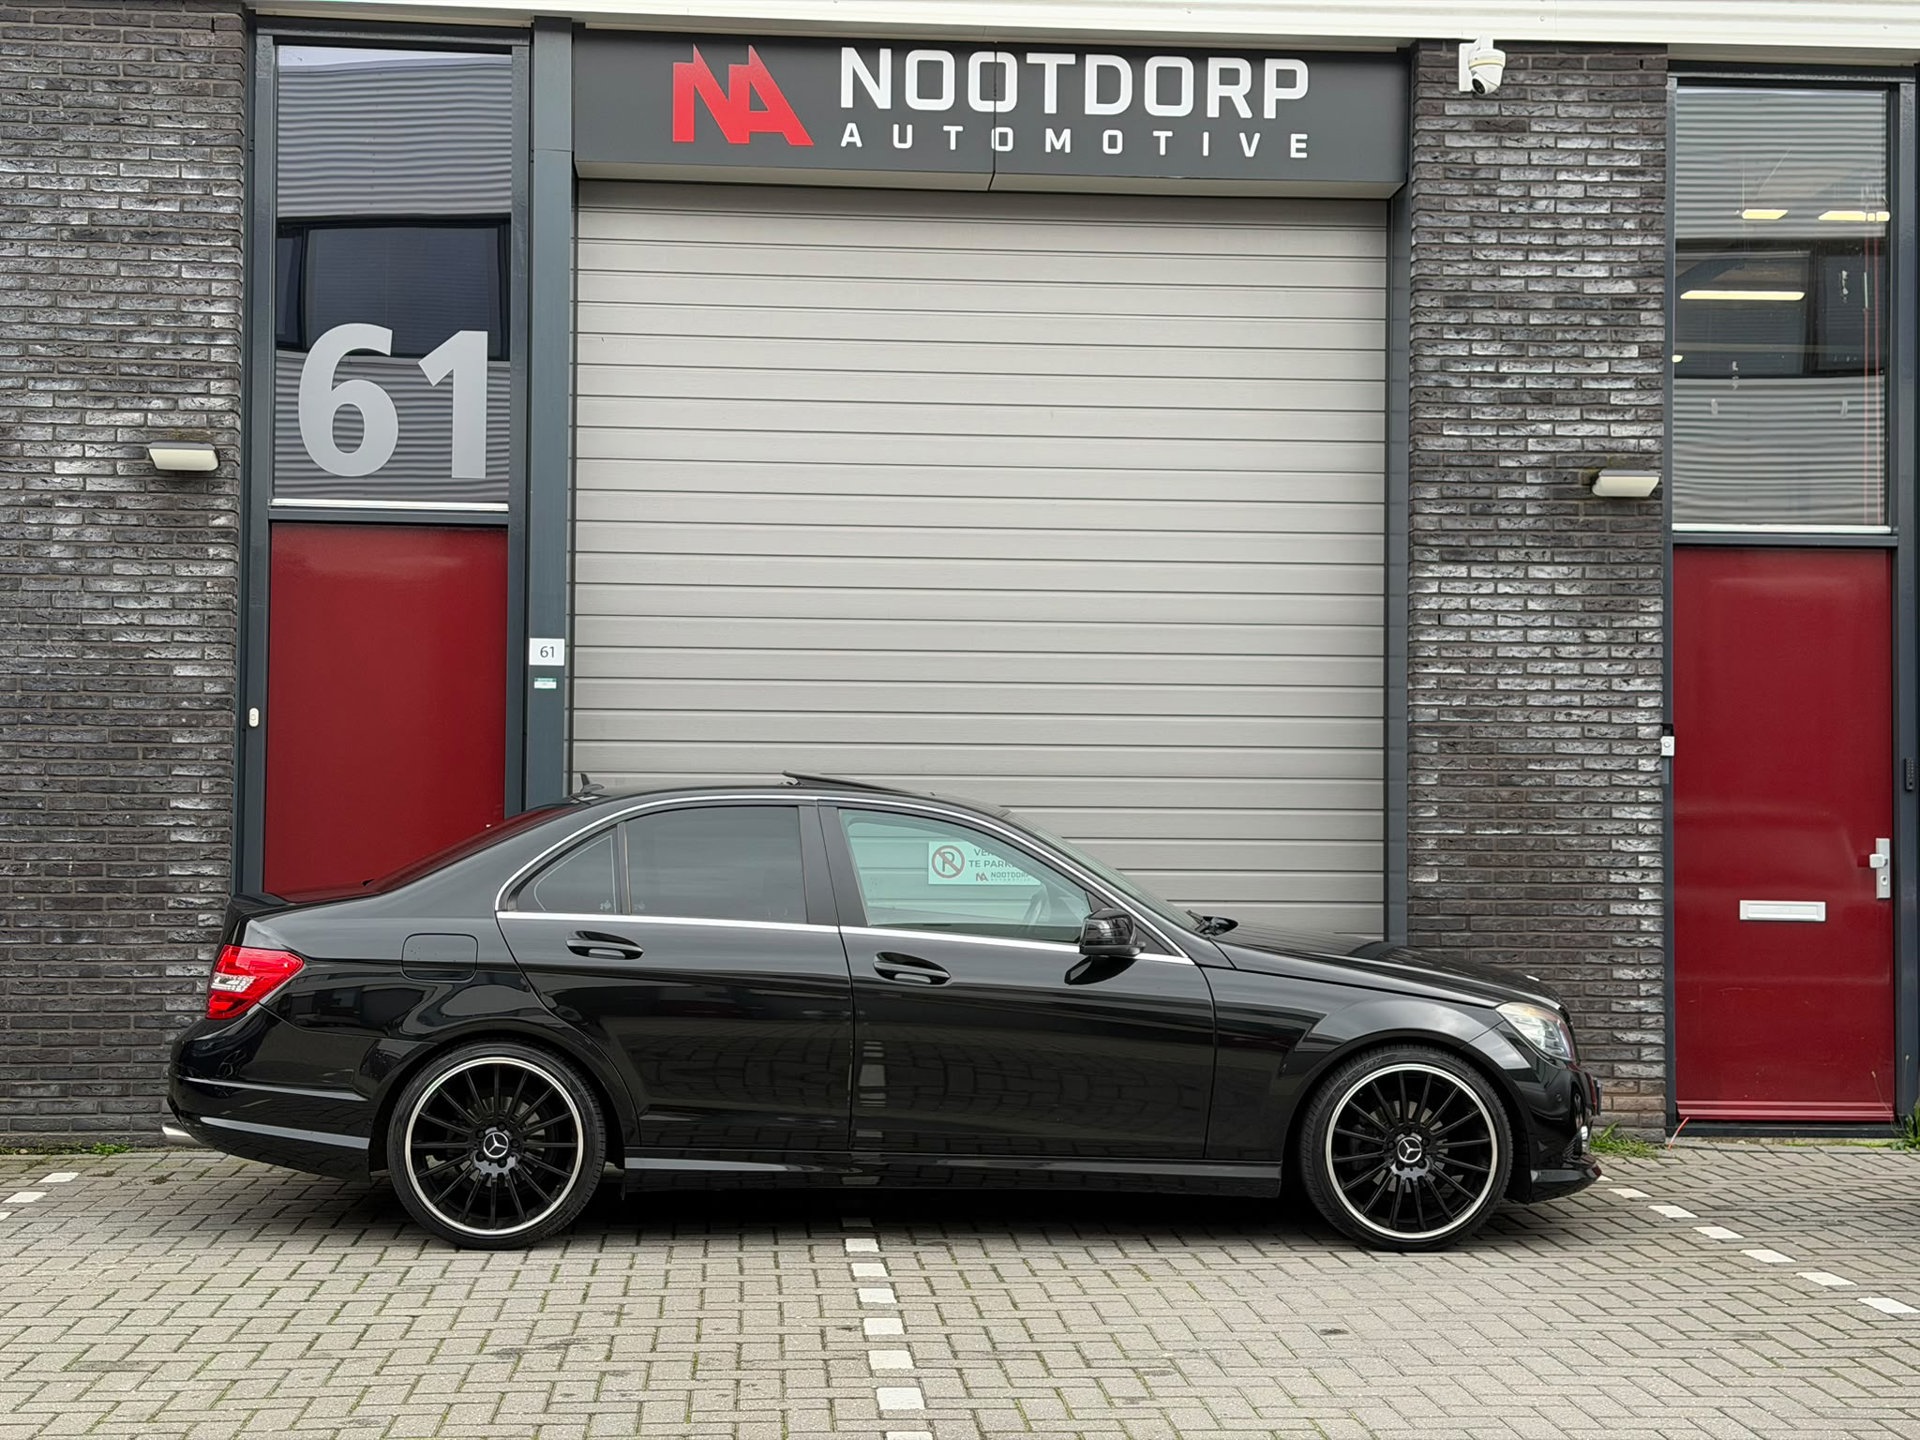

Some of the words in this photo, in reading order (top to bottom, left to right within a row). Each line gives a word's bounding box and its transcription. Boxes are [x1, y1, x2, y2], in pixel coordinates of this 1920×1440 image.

[673, 44, 814, 145] NA
[840, 46, 1309, 119] NOOTDORP
[841, 123, 1308, 158] AUTOMOTIVE
[298, 323, 488, 479] 61
[540, 646, 555, 658] 61
[969, 860, 981, 868] TE
